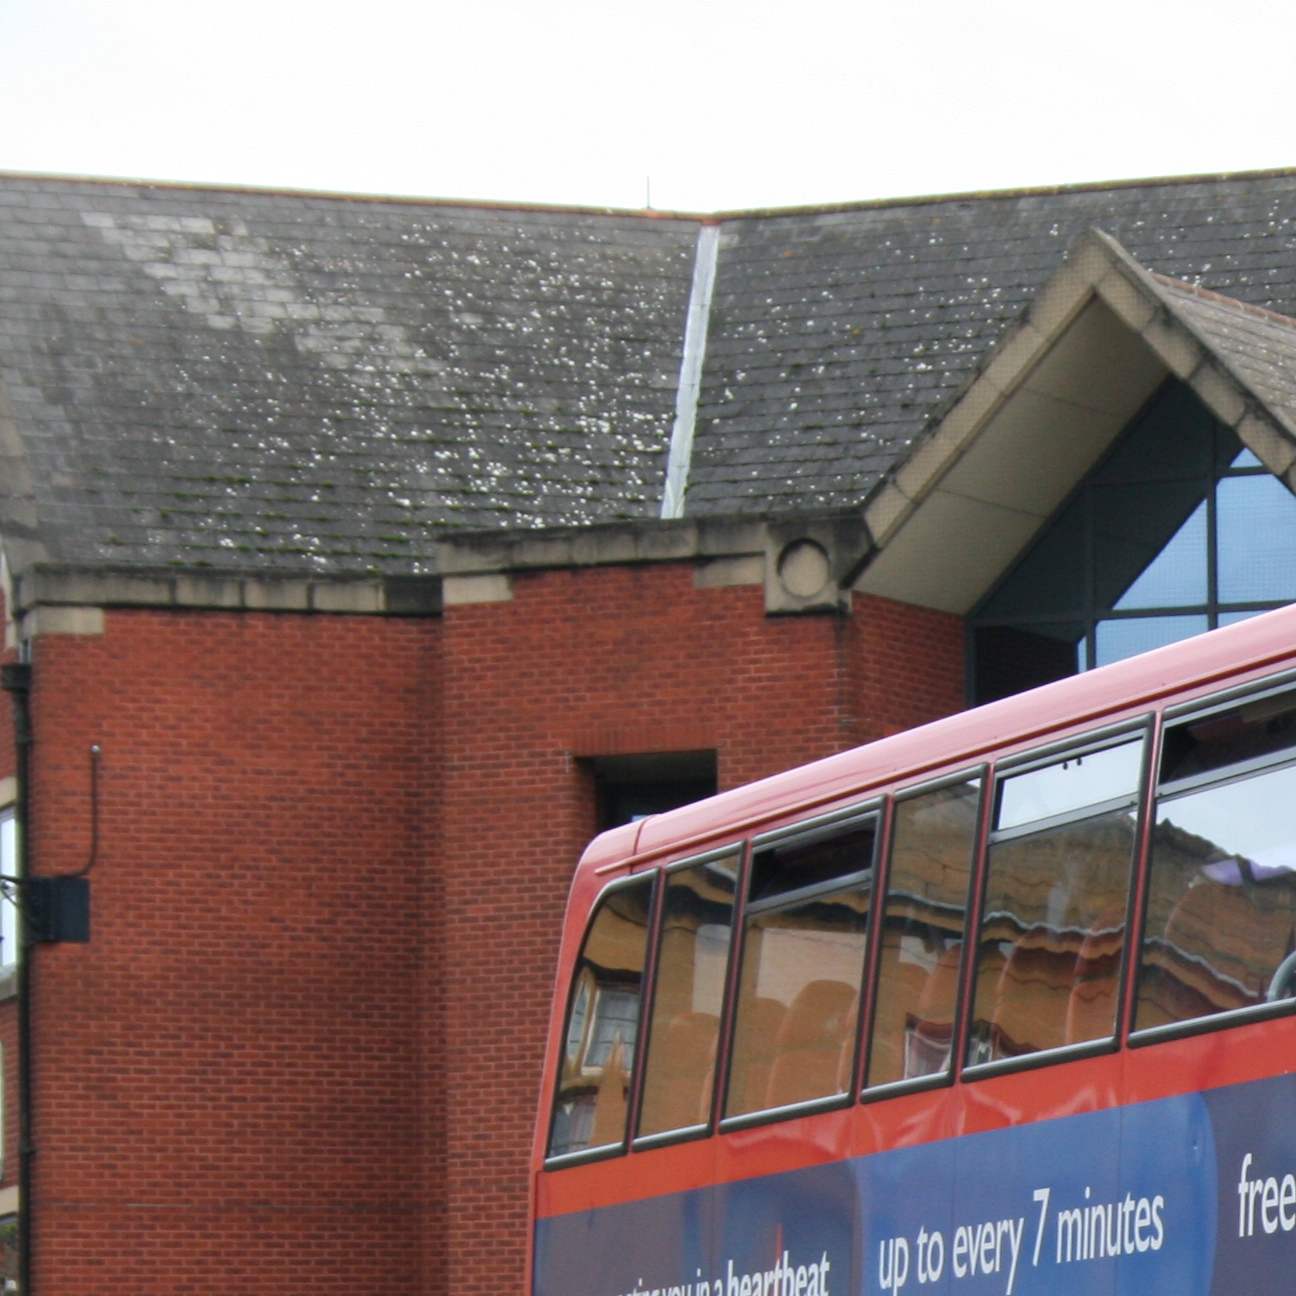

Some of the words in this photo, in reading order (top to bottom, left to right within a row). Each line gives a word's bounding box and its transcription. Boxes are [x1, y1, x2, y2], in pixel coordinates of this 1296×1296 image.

[916, 1226, 945, 1285] to
[952, 1217, 1026, 1296] every
[1032, 1187, 1053, 1268] 7
[1056, 1186, 1166, 1264] minutes
